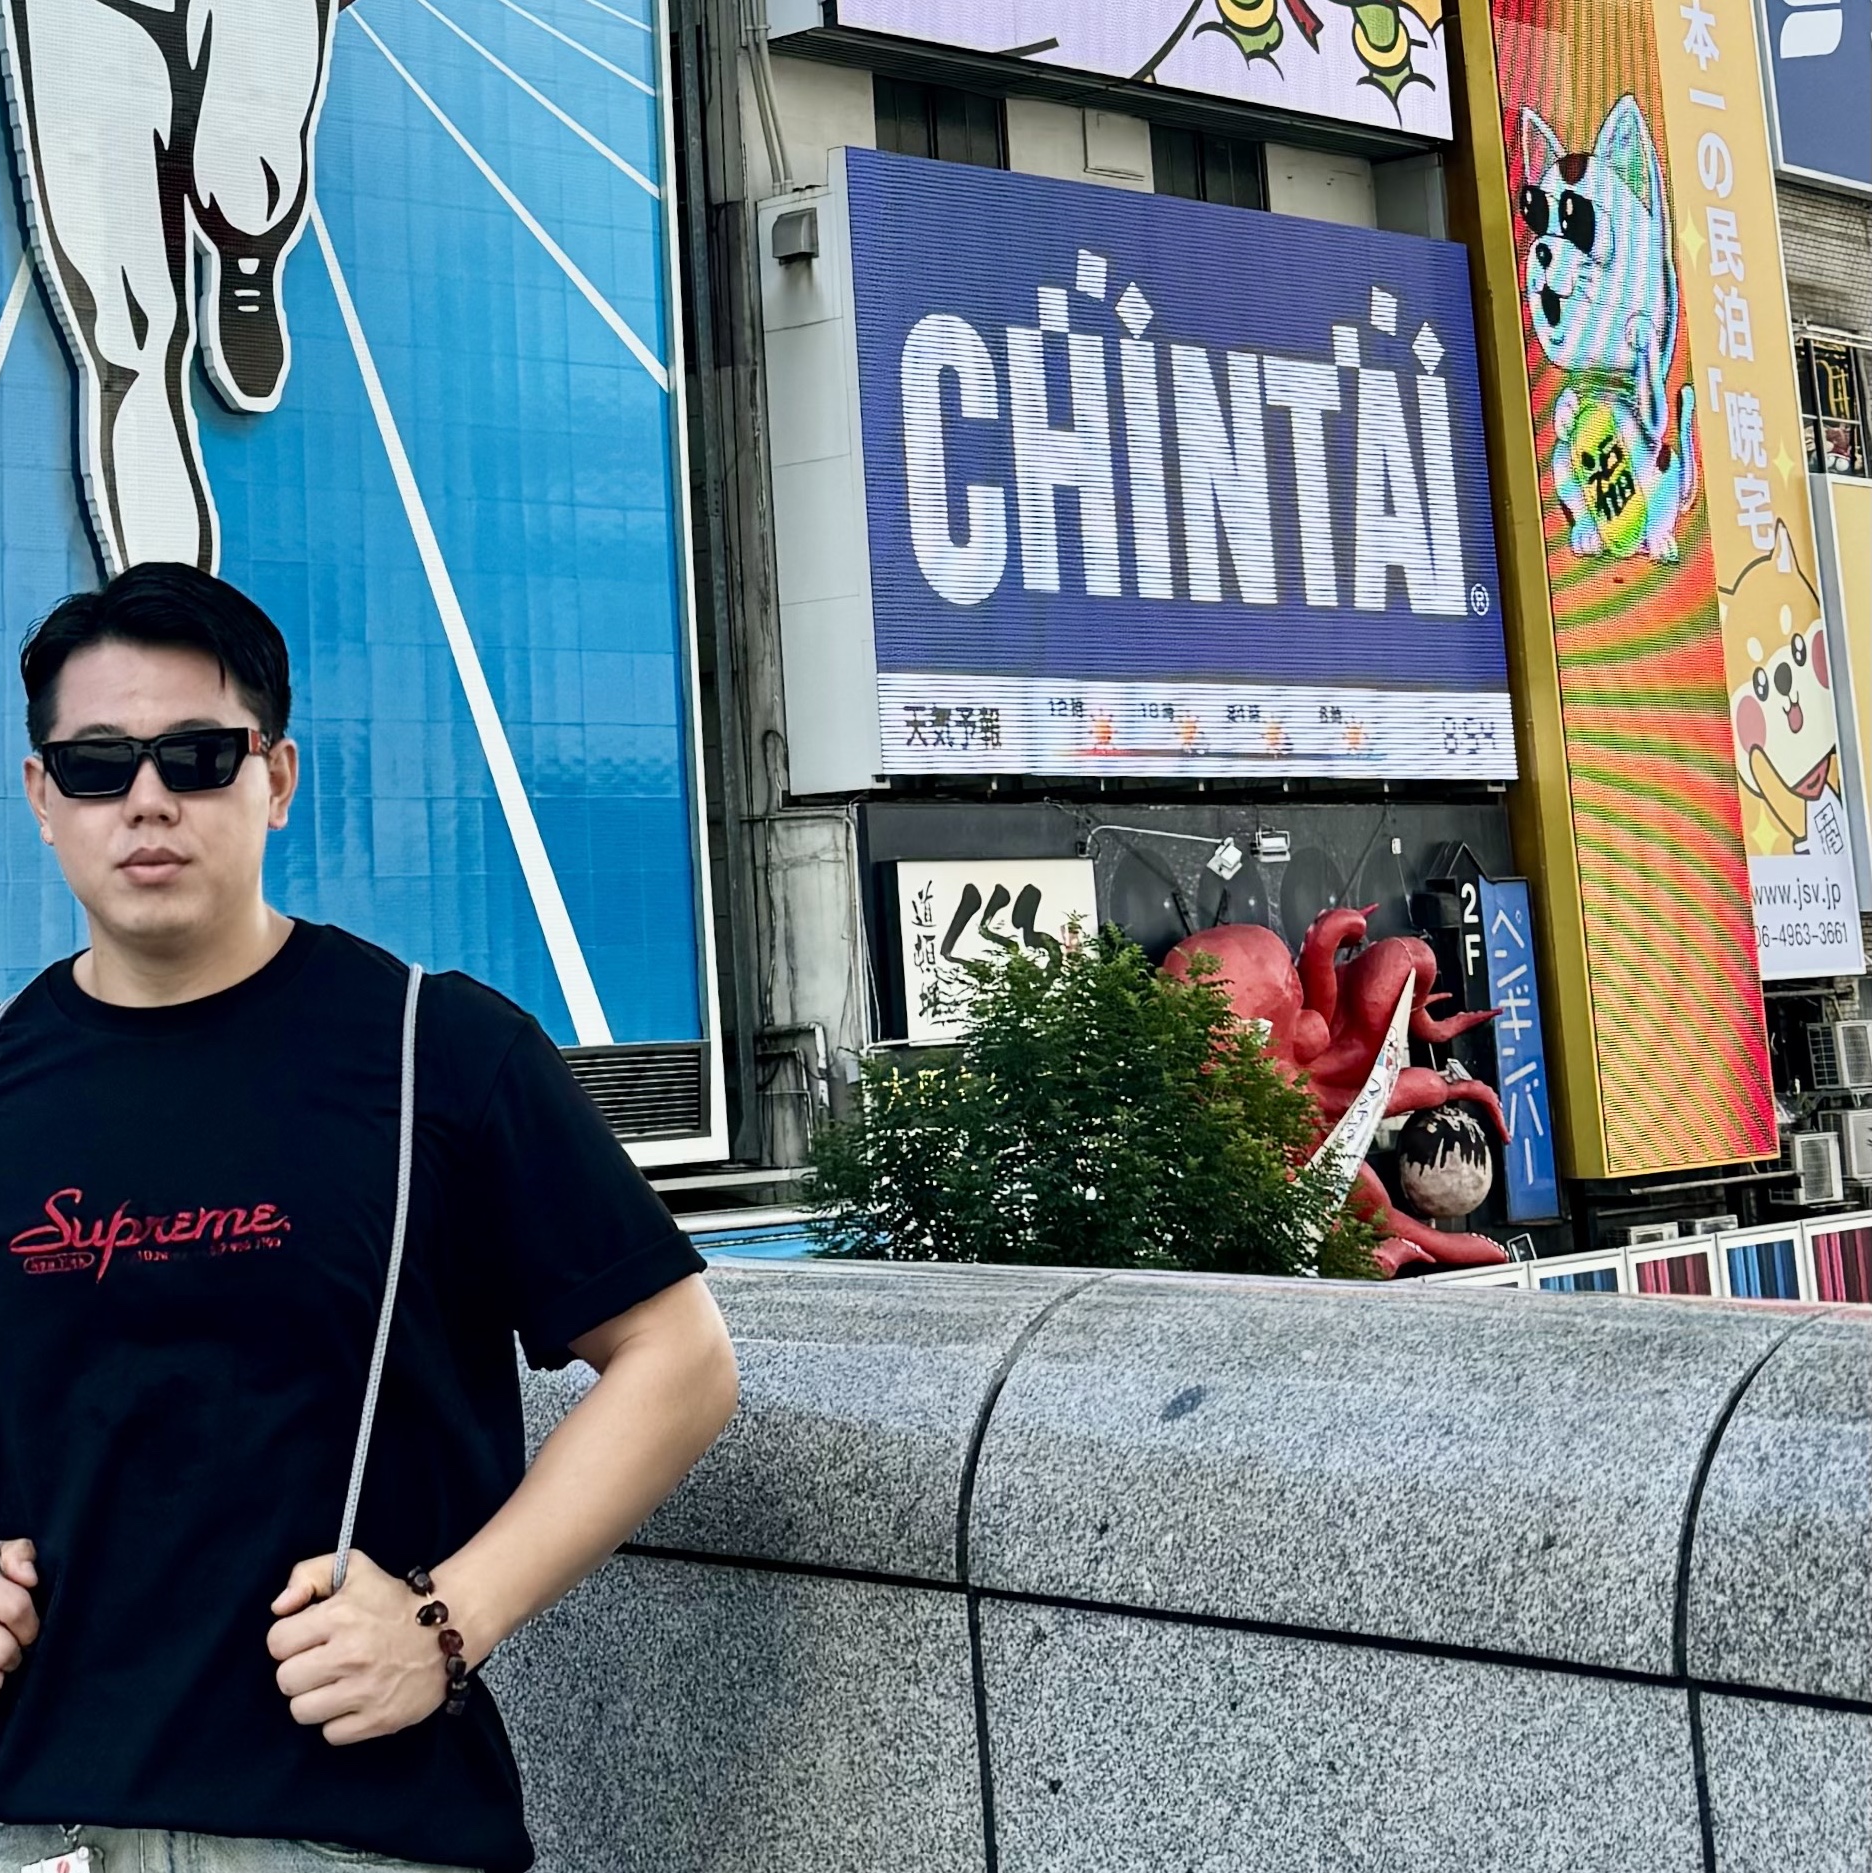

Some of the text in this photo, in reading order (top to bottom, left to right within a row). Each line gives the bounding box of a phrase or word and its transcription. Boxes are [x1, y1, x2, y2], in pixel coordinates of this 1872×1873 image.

[903, 703, 1002, 752] 天気予報
[1491, 908, 1544, 1186] ペンギンバー
